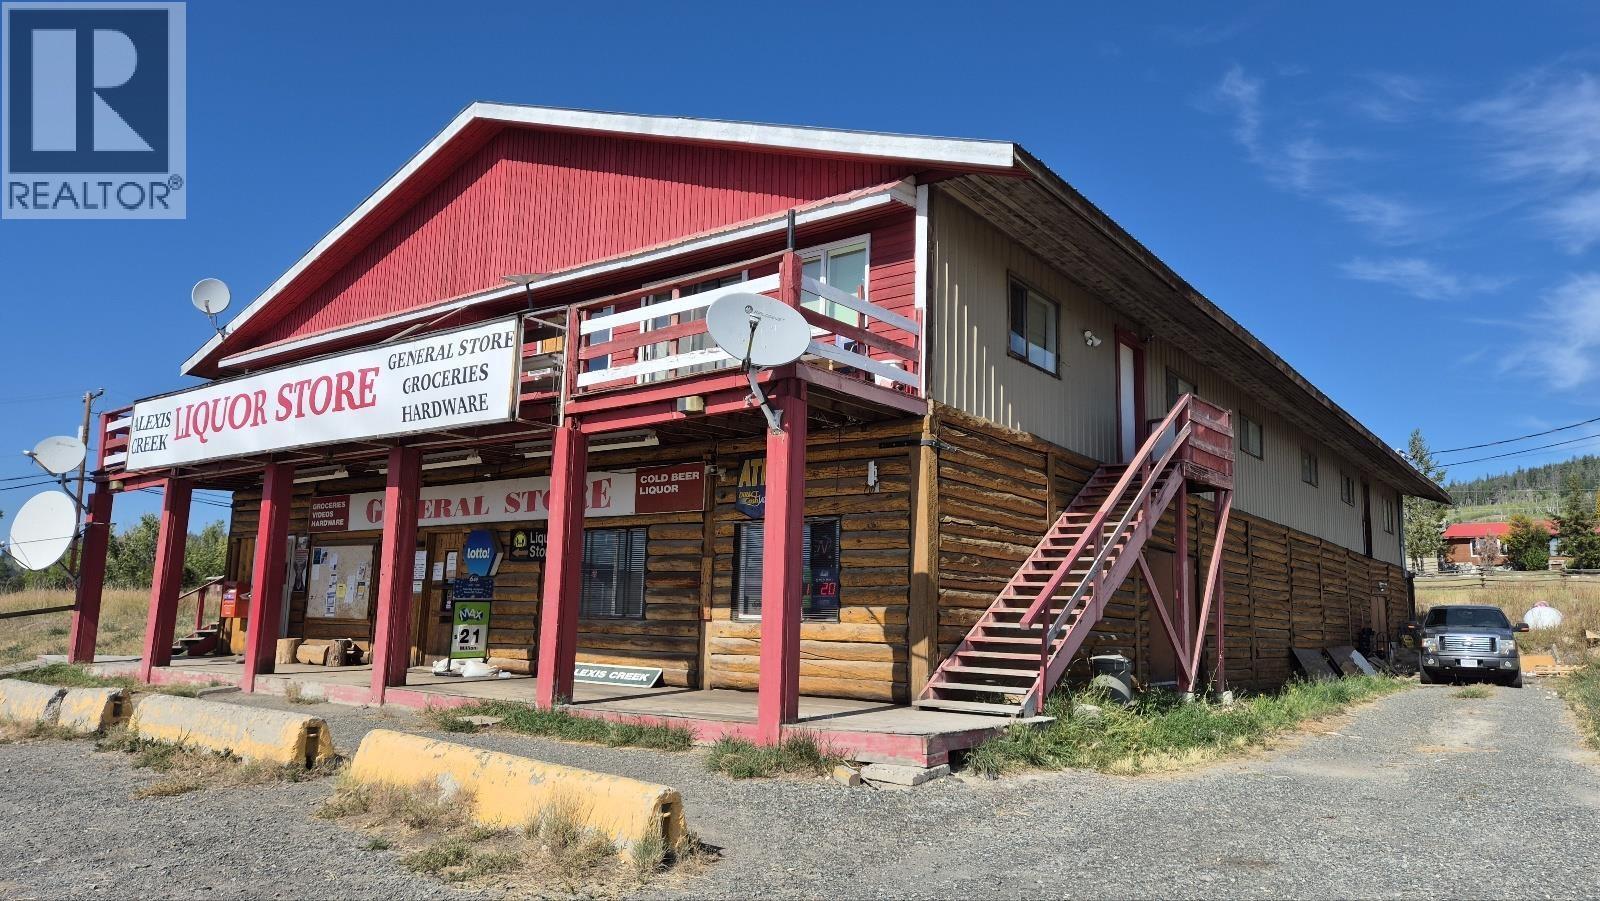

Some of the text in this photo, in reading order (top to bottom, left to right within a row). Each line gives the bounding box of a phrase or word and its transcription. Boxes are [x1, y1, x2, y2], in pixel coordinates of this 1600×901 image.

[388, 330, 515, 371] GENERAL STORE
[402, 363, 489, 395] GROCERIES
[174, 366, 380, 444] LIQUOR STORE
[401, 393, 489, 423] HARDWARE
[133, 411, 172, 433] ALEXIS
[131, 433, 168, 455] CREEK
[640, 470, 700, 484] COLD BEER
[738, 458, 767, 487] AT
[639, 483, 679, 496] LIQUOR
[312, 501, 346, 510] GROCERIES
[312, 510, 334, 518] VIDEOS
[365, 495, 490, 524] GERAL
[311, 519, 344, 527] HARDWARE
[530, 531, 548, 546] Liqu
[529, 545, 547, 558] Sto
[574, 668, 650, 682] LEXIS CREEK
